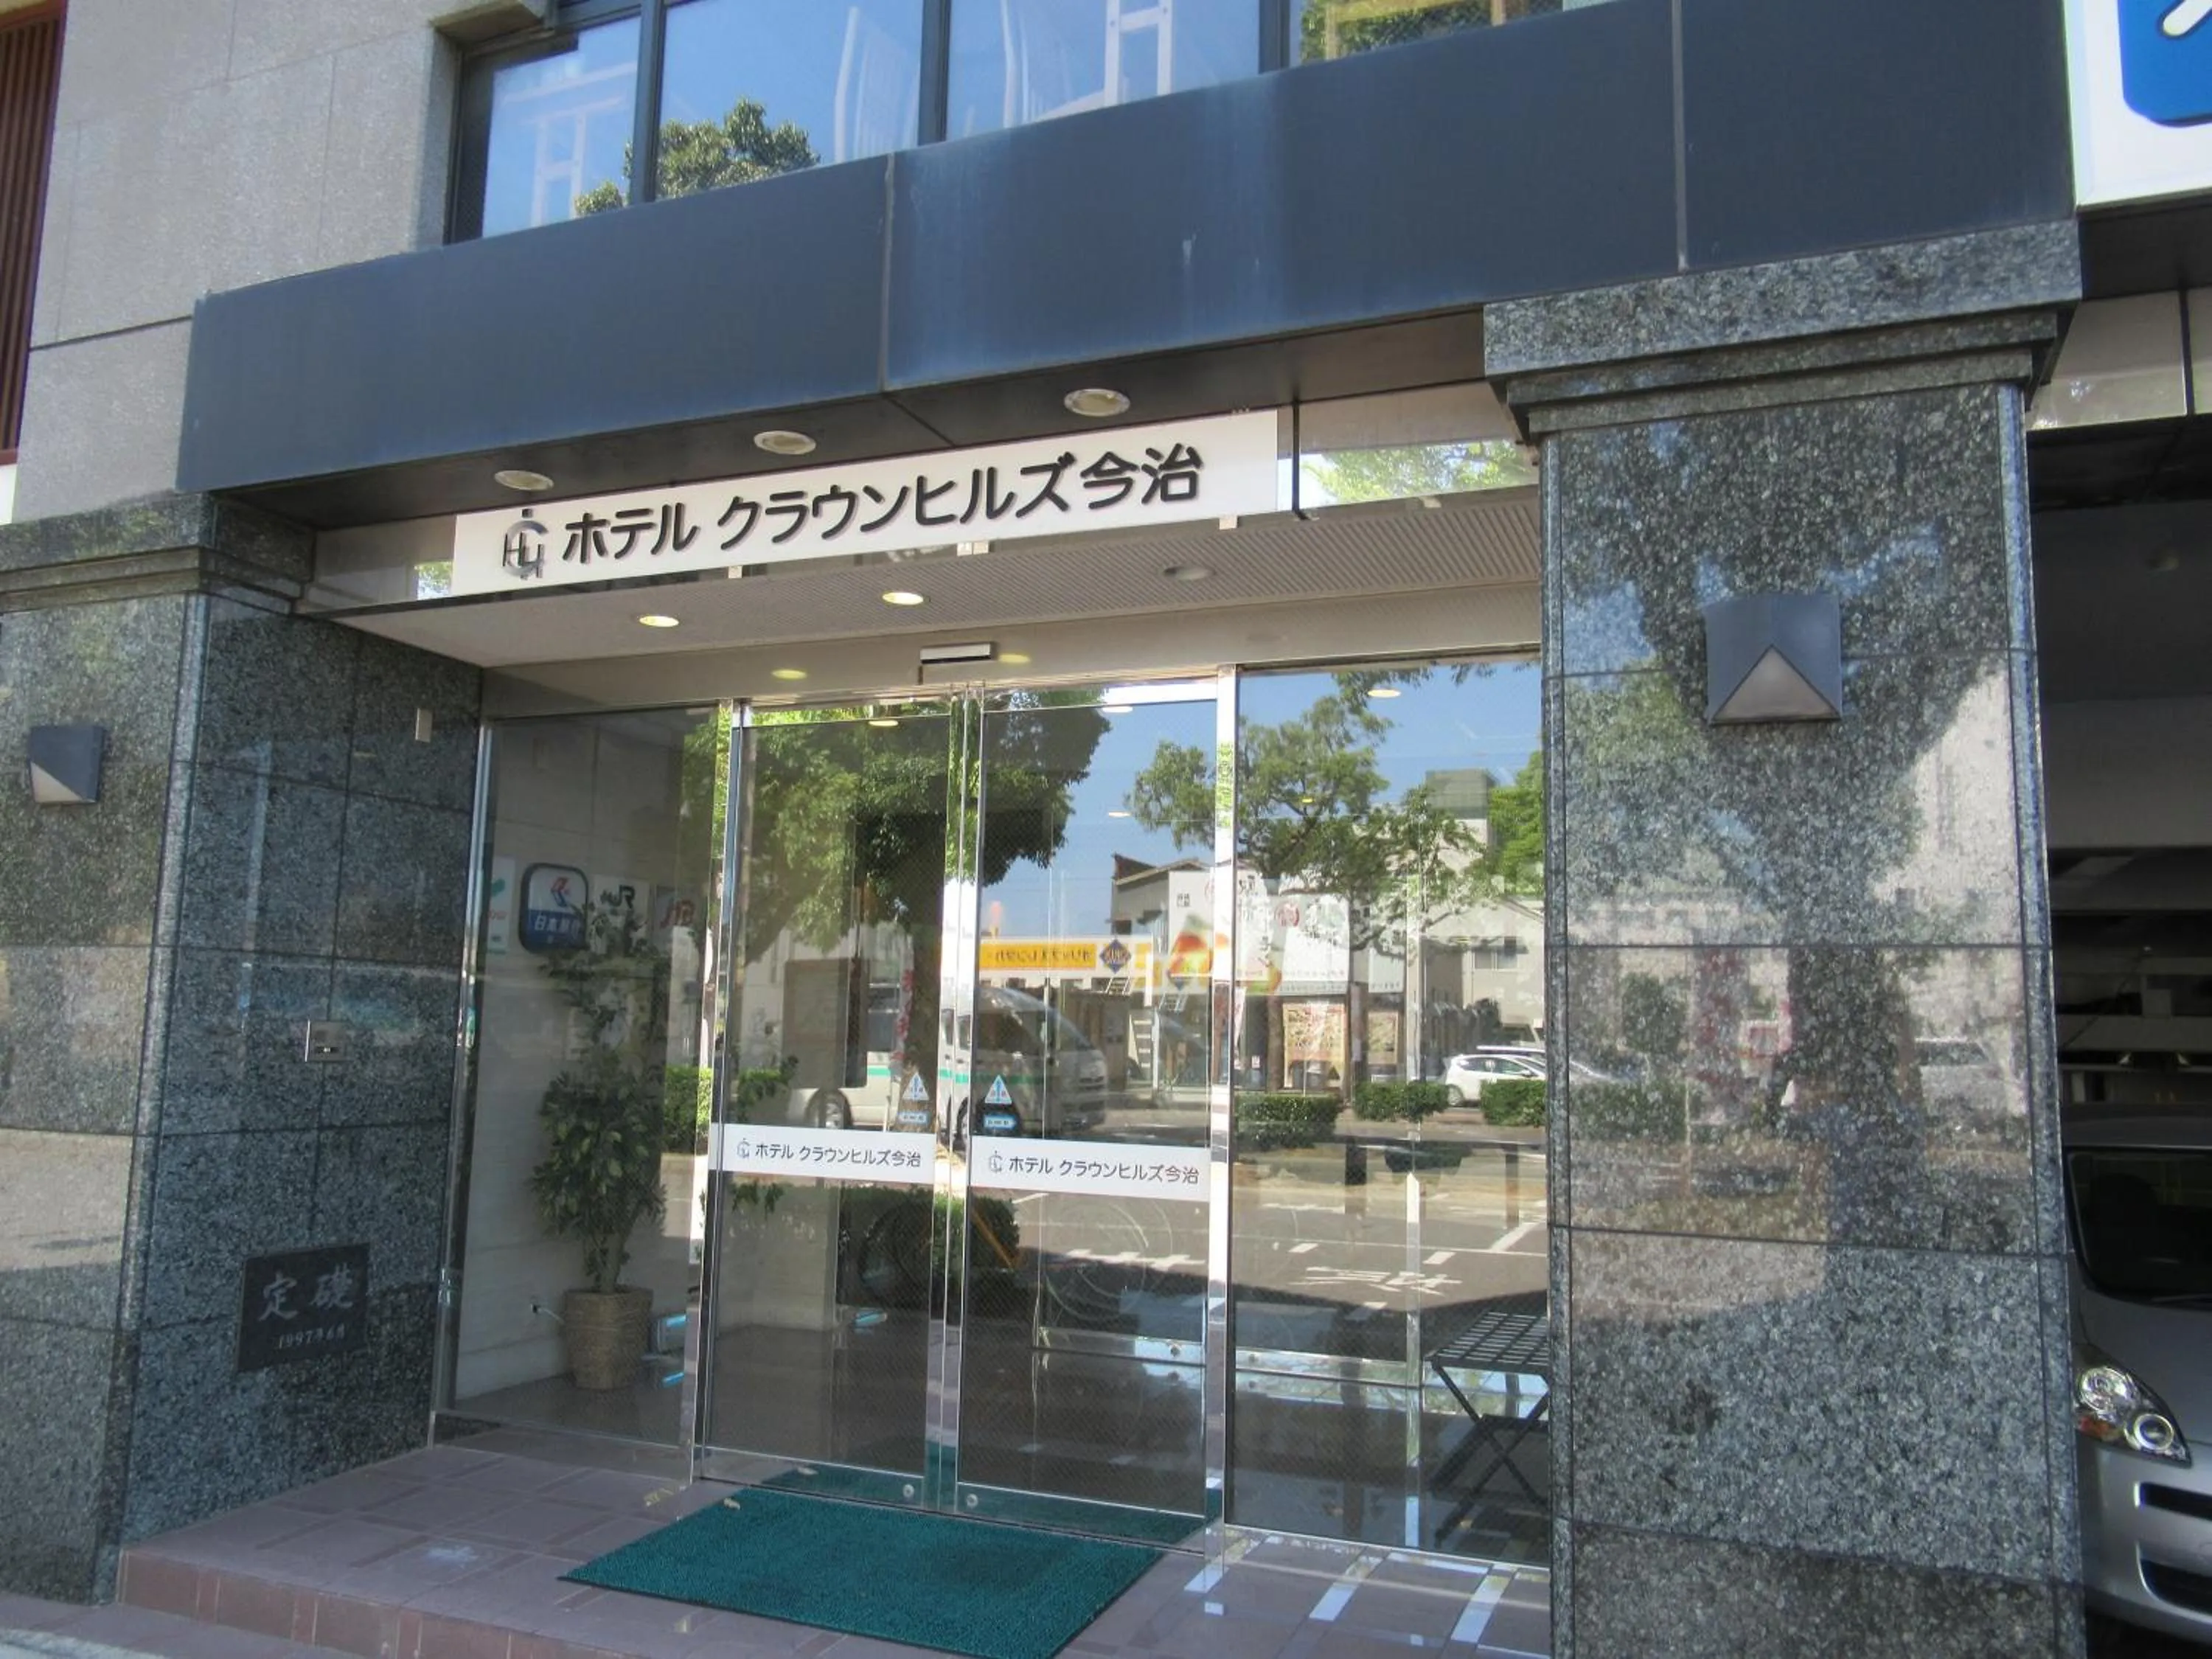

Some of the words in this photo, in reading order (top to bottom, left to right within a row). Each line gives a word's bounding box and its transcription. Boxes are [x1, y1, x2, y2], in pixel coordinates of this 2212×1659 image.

[562, 501, 700, 566] ホテル
[717, 442, 1204, 552] クラウンヒルズ今治
[756, 1144, 794, 1159] ホテル
[799, 1145, 921, 1168] クラウンヒルズ今治
[1009, 1157, 1053, 1174] ホテル
[1060, 1160, 1200, 1185] クラウンヒルズ今治
